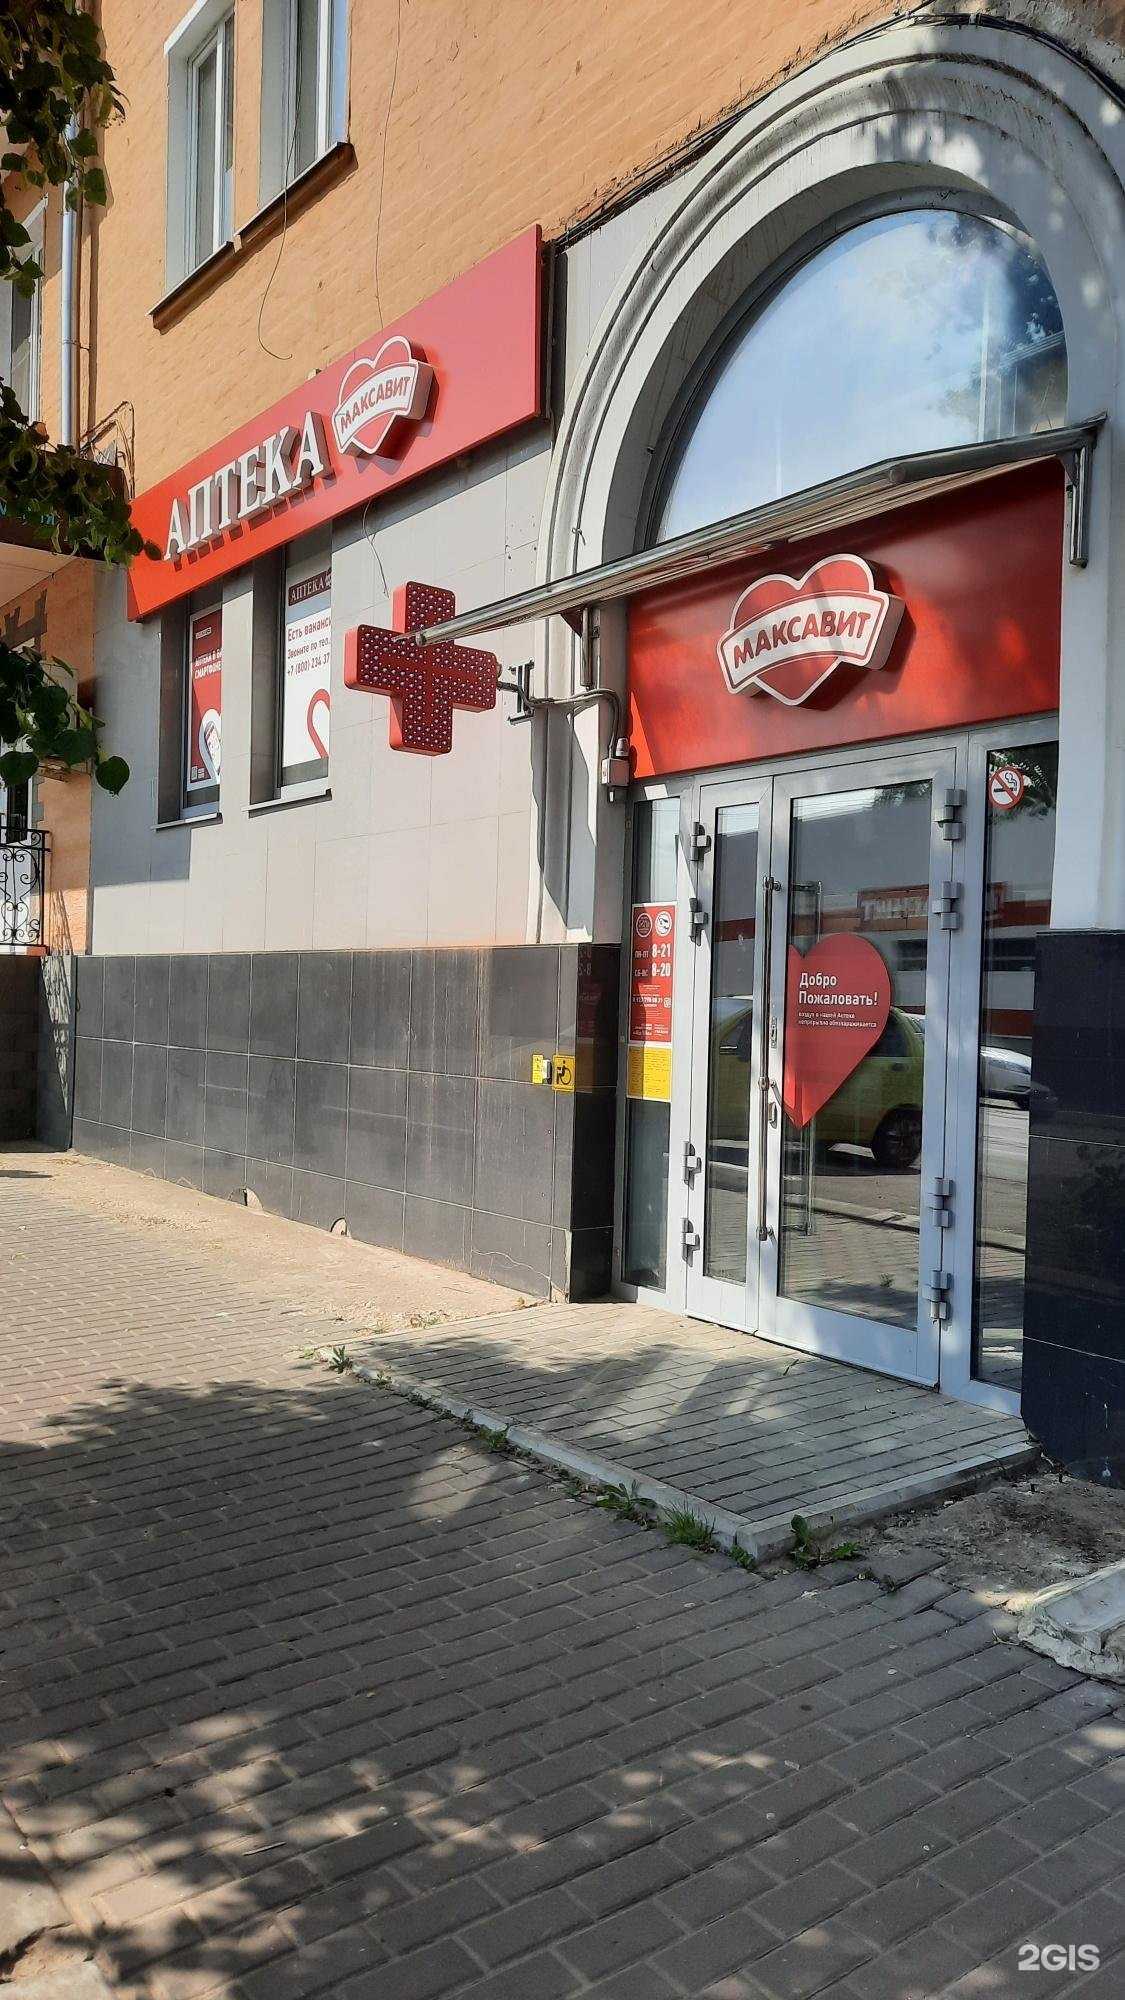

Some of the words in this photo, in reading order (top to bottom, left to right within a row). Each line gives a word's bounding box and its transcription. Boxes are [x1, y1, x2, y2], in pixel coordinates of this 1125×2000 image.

[340, 376, 411, 434] МАКСАВИТ
[163, 410, 324, 560] АПТЕКА
[290, 575, 326, 602] АПТЕКА
[287, 625, 303, 642] Есть
[733, 610, 871, 669] МАКСАВИТ
[310, 640, 318, 652] по
[652, 943, 671, 959] 8-21
[651, 961, 671, 978] 8-20
[799, 972, 837, 989] Добро
[798, 990, 878, 1006] Пожаловать!
